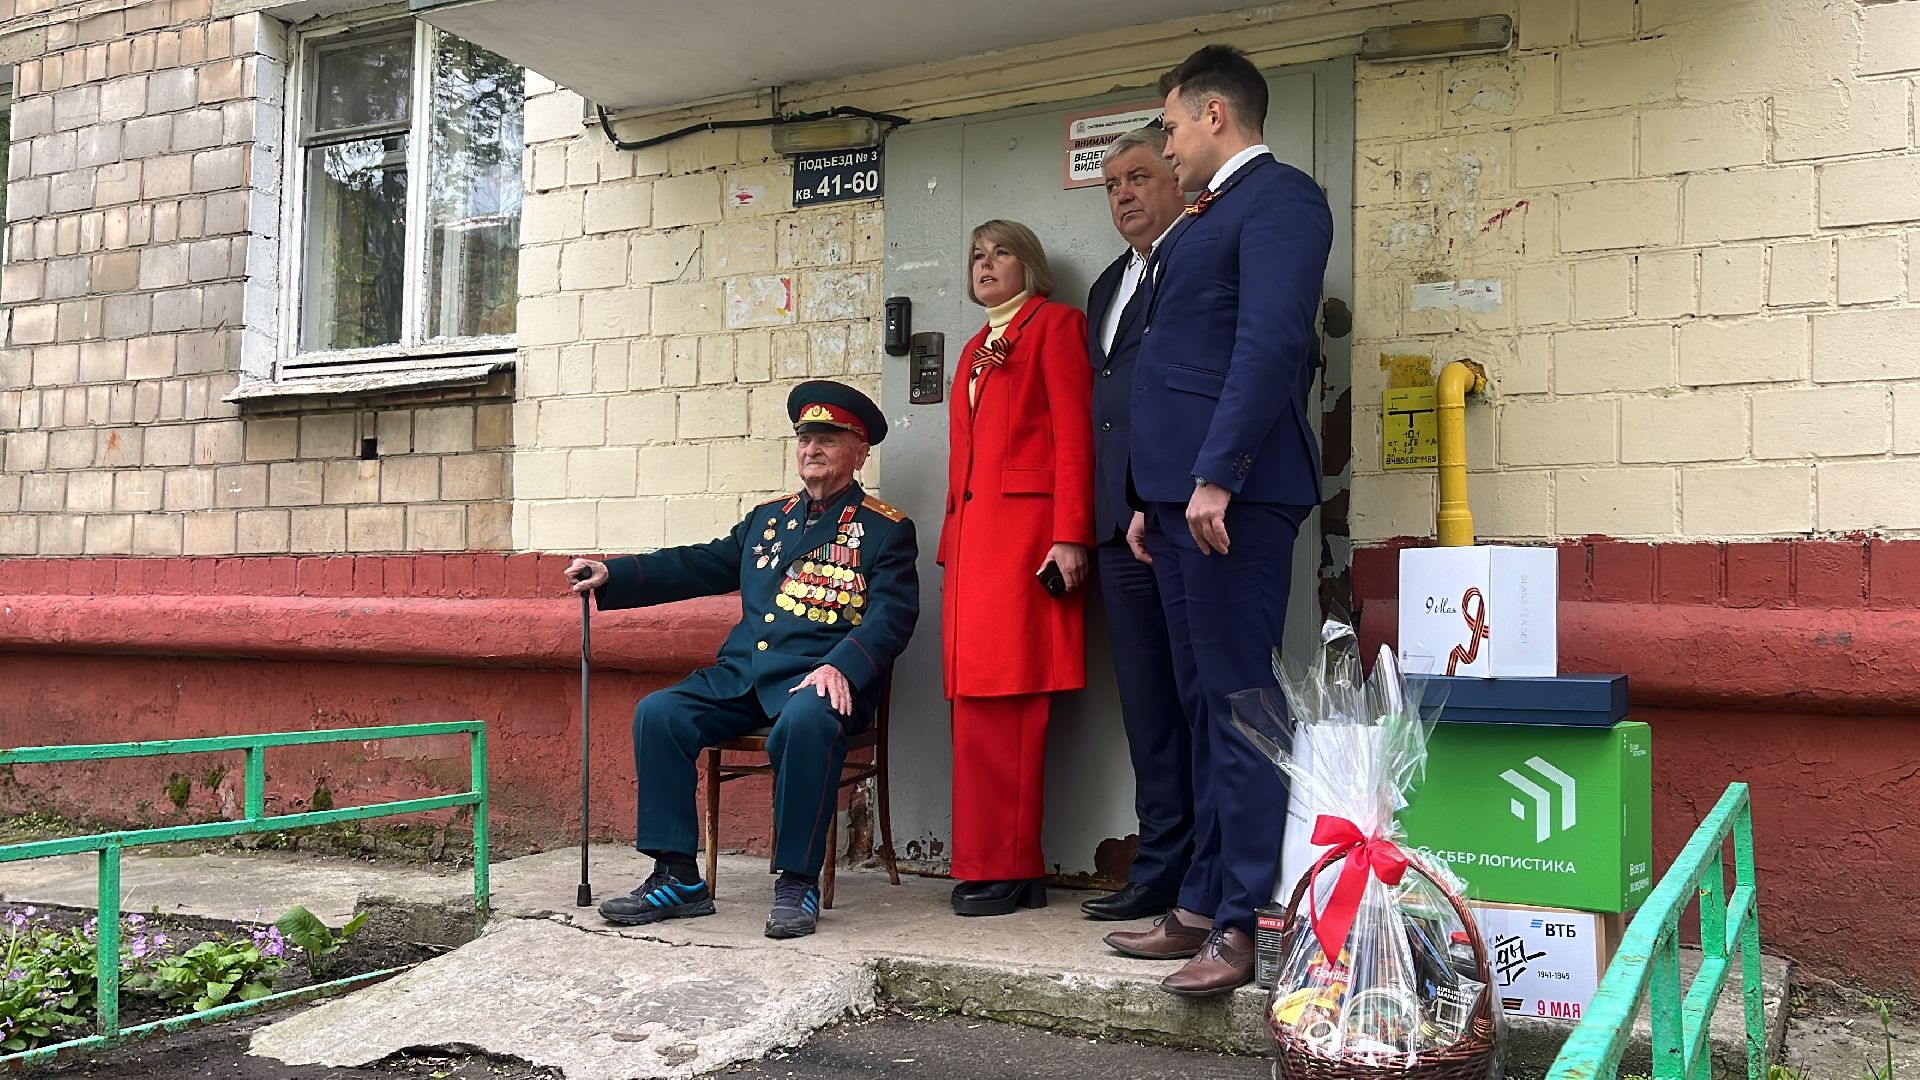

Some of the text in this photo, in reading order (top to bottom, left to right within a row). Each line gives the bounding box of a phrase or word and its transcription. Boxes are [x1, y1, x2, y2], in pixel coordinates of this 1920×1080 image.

[799, 150, 878, 171] ПОДЪЕЗД № 3
[1074, 150, 1105, 162] ВЕДЕТ
[1074, 160, 1102, 172] ВИДЕ
[816, 169, 879, 197] 41-60
[1425, 596, 1435, 615] 9
[1520, 574, 1529, 644] GLASS TEA SET
[1437, 850, 1577, 874] СБЕР ЛОГИСТИКА
[1545, 923, 1577, 938] ВТБ
[1537, 970, 1570, 980] 1941-1945
[1537, 999, 1581, 1019] 9 МАЯ
